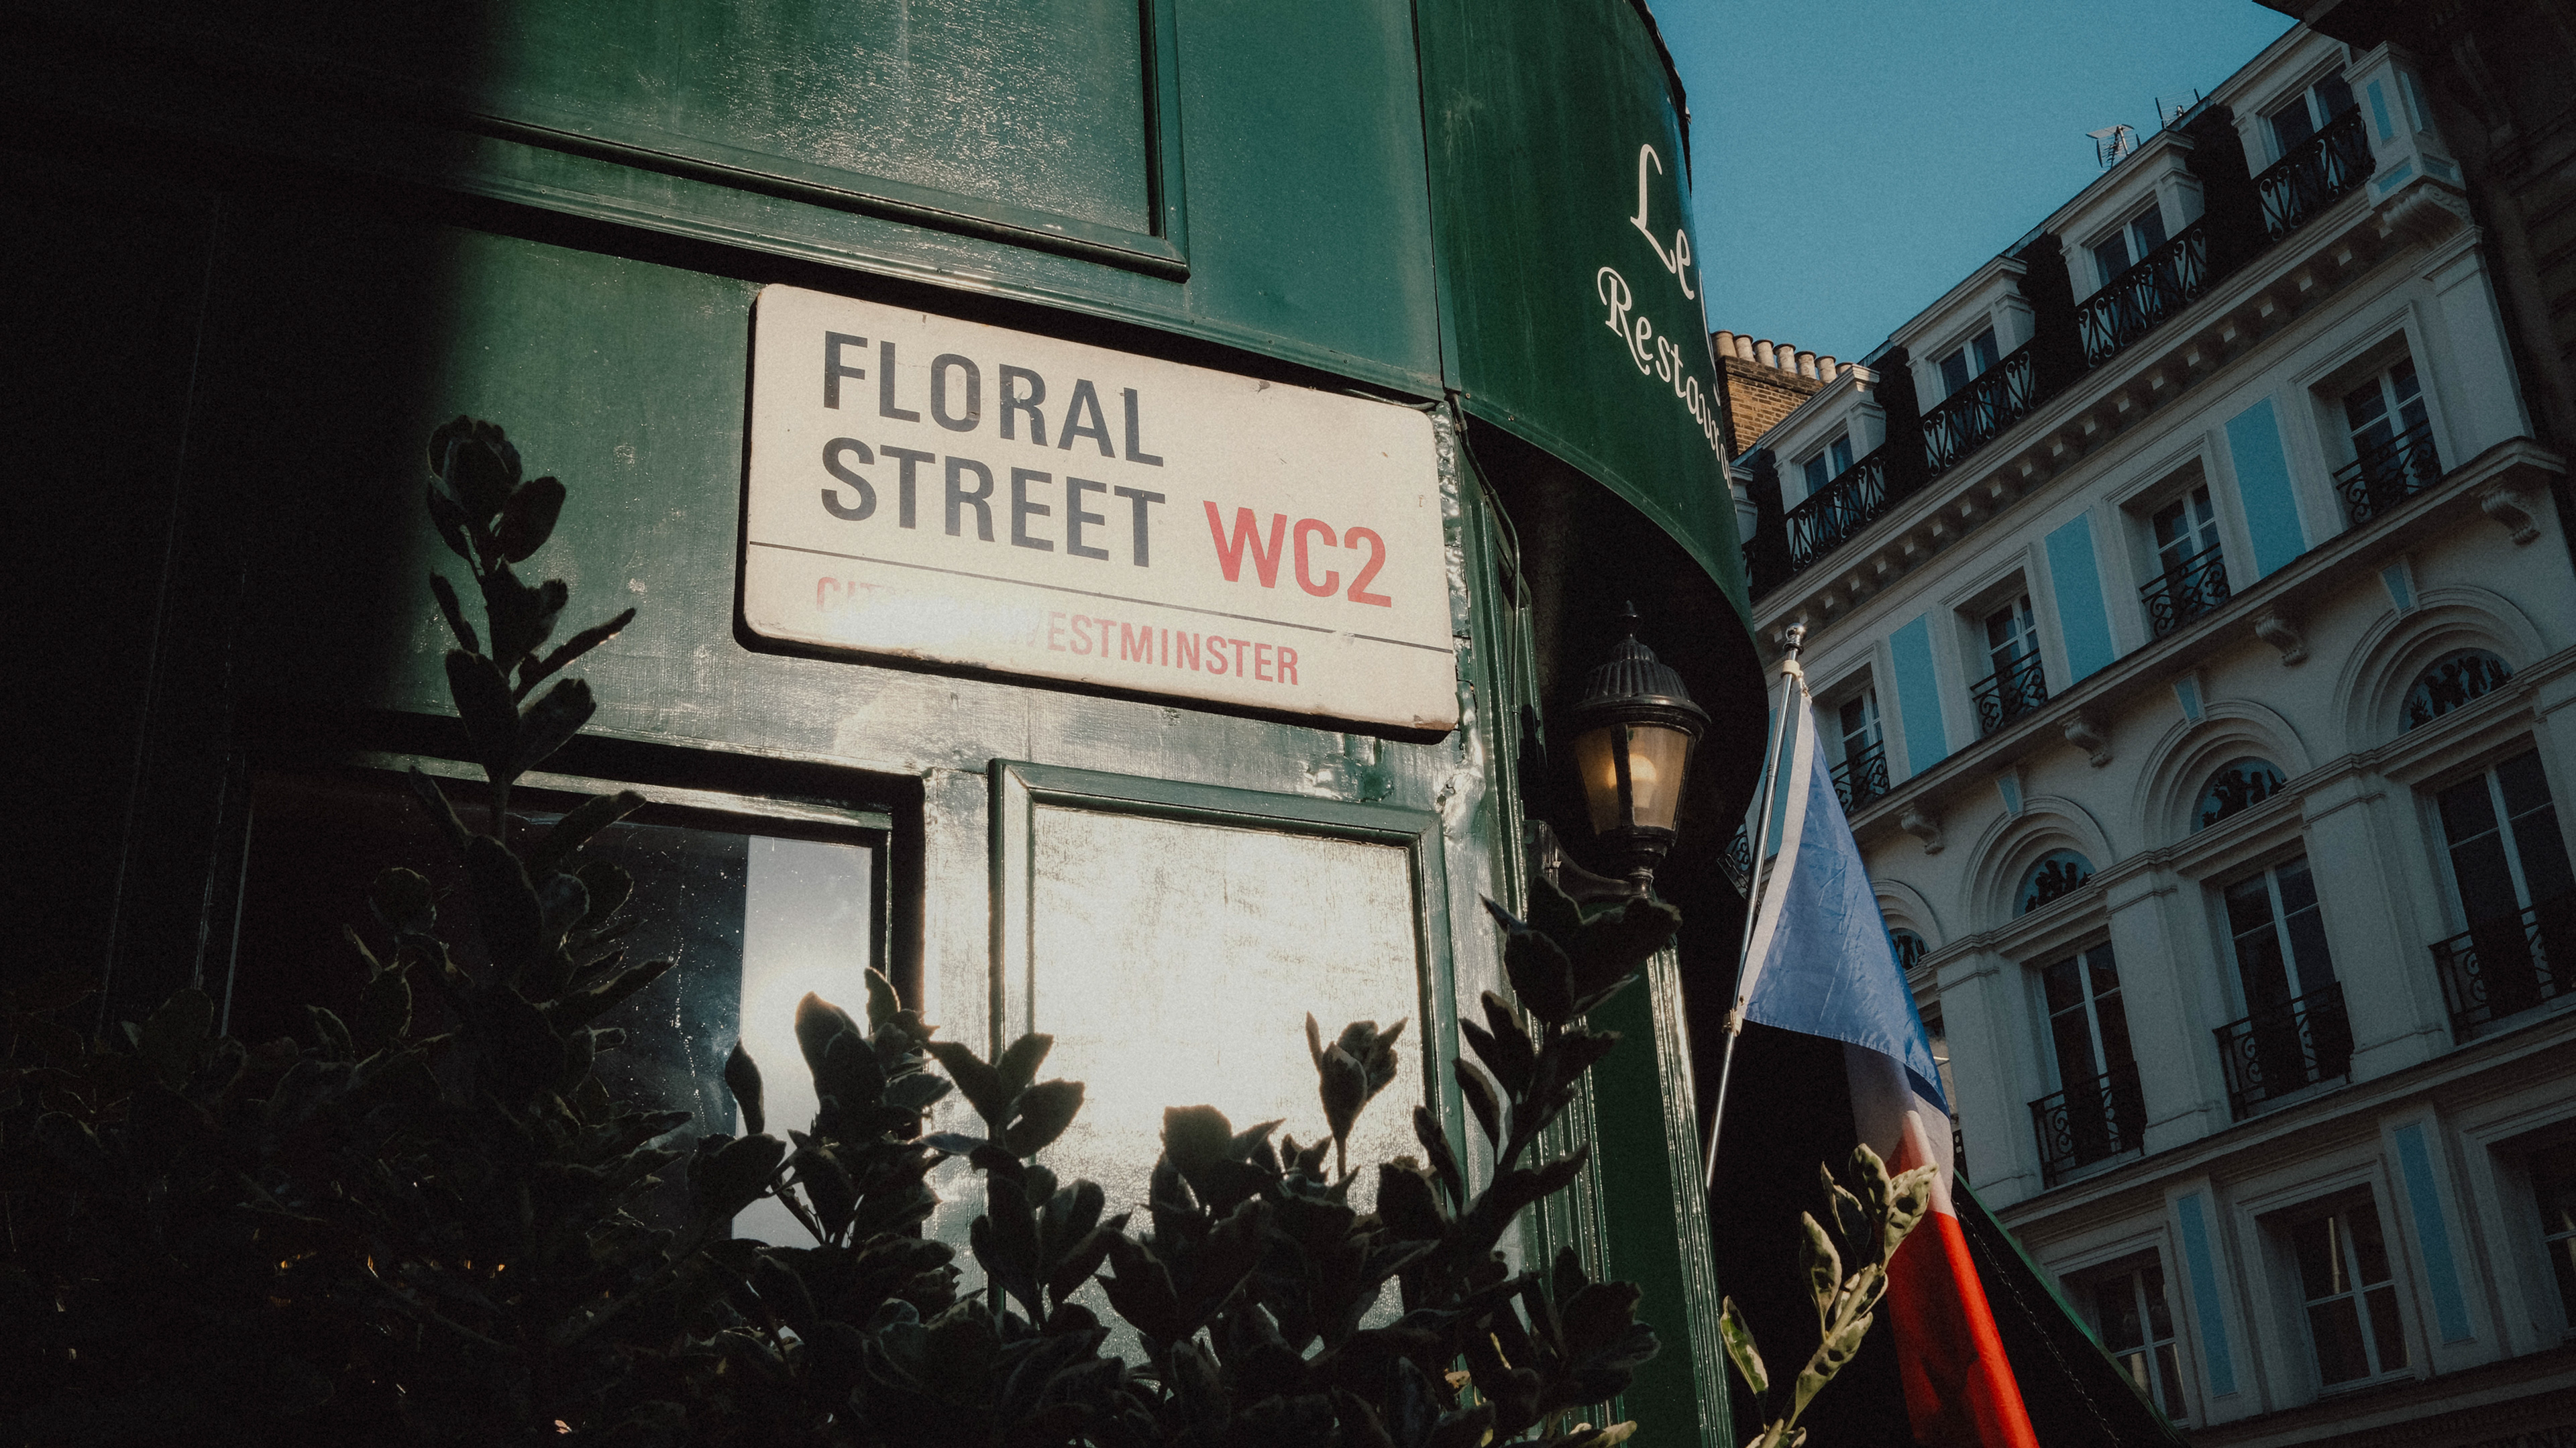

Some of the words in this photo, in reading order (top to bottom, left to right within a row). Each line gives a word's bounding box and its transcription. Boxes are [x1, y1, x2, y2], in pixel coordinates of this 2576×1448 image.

[1631, 143, 1695, 301] Le
[824, 331, 1164, 467] FLORAL
[821, 437, 1166, 568] STREET
[1203, 500, 1393, 608] WC2
